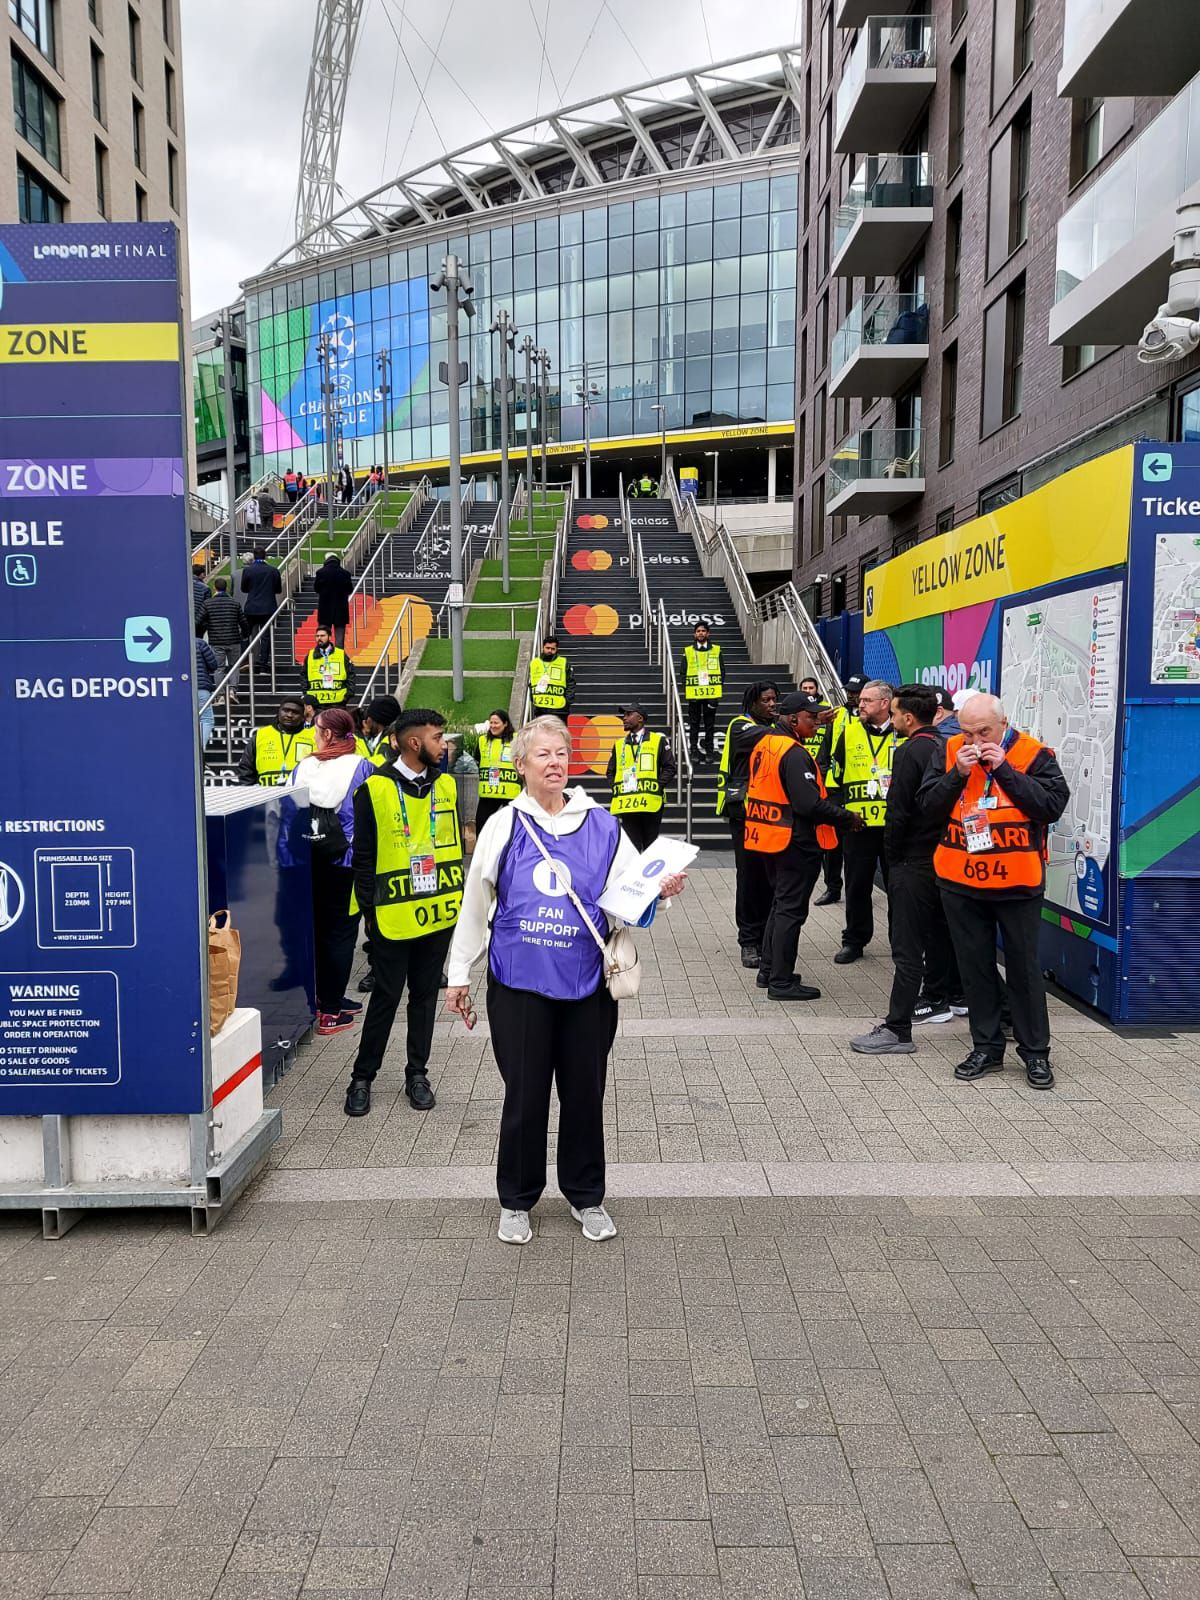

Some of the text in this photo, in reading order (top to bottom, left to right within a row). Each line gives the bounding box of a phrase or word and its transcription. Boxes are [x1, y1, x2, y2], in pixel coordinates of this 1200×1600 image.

[91, 245, 110, 258] 24
[114, 244, 167, 257] FINAL
[8, 330, 87, 355] ZONE
[720, 428, 748, 437] YELLOW
[7, 465, 87, 490] ZONE
[1141, 496, 1200, 516] Ticke
[613, 517, 670, 527] pceless
[1, 521, 64, 546] IBLE
[619, 553, 690, 566] pceless
[911, 534, 1006, 596] YELLOW ZONE
[629, 609, 727, 630] pieless
[685, 675, 722, 686] STEARD
[970, 659, 992, 695] 24
[15, 677, 173, 698] BAG DEPOSIT
[479, 769, 519, 782] STEARD
[613, 780, 660, 796] STEARD
[617, 796, 648, 810] 1264
[5, 820, 105, 833] RESTRICTIONS
[99, 854, 113, 862] SIZE
[963, 859, 1009, 881] 684
[65, 891, 89, 899] DEPTH
[105, 891, 130, 899] HEIGHT
[64, 899, 90, 907] 210MM
[414, 899, 462, 928] 015
[537, 906, 564, 920] FAN
[519, 919, 580, 938] SUPPORT
[522, 935, 573, 949] HERE TO HELP
[9, 984, 80, 998] WARNING
[9, 1009, 25, 1017] YOU
[27, 1009, 45, 1017] MAY
[46, 1009, 57, 1017] BE
[22, 1020, 47, 1028] SPACE
[4, 1031, 31, 1039] ORDER
[42, 1030, 89, 1038] OPERATION
[7, 1047, 36, 1055] STREET
[8, 1068, 61, 1076] SALE/RESALE
[62, 1068, 73, 1076] OF
[75, 1067, 108, 1075] TICKETS
